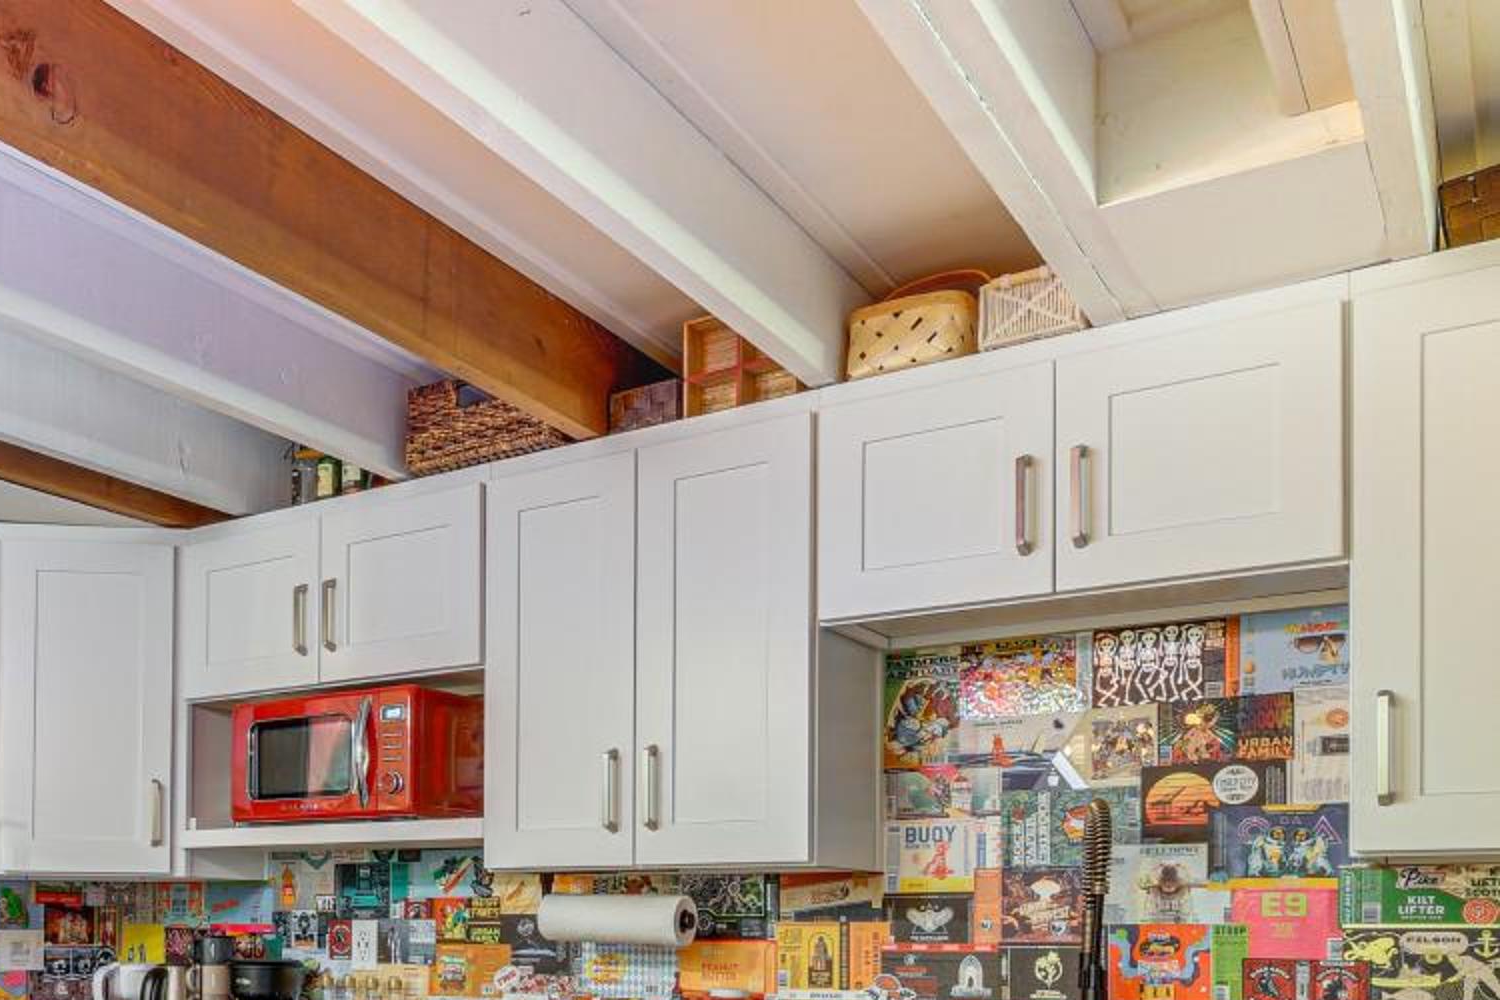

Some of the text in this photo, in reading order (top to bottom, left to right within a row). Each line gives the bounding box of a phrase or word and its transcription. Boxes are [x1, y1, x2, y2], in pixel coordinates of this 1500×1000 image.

[1238, 736, 1292, 748] URBAN
[1237, 748, 1293, 758] FAMILY
[905, 826, 956, 843] BUOY
[1261, 892, 1307, 917] E9
[1407, 896, 1436, 904] KILT
[1397, 906, 1445, 914] LIFTER
